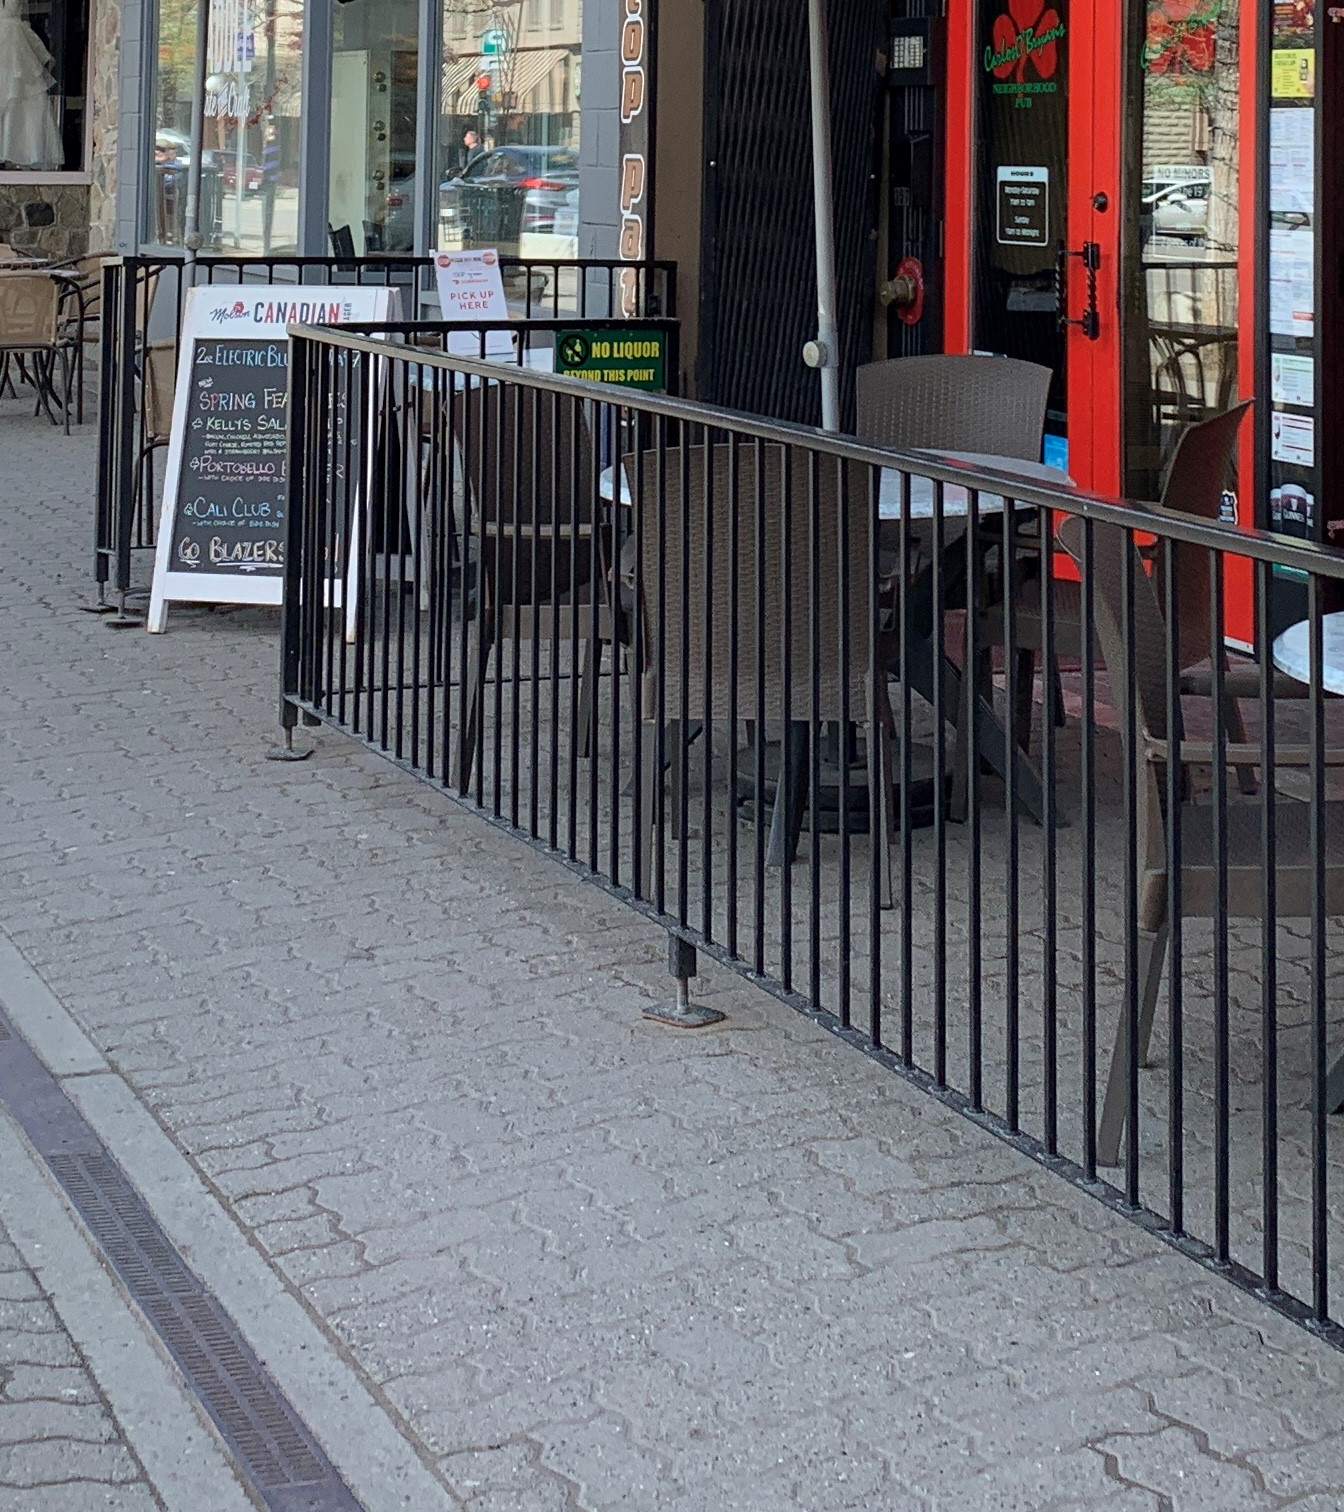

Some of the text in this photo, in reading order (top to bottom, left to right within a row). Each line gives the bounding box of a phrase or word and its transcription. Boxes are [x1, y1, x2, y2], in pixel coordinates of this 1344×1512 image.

[450, 290, 494, 300] PICK UP
[253, 301, 340, 324] CANADIAN
[459, 300, 489, 310] HERE
[215, 344, 265, 366] ELECTRIC
[591, 341, 660, 360] NO LIQUOR
[602, 369, 625, 382] THIS
[626, 369, 655, 382] POINT
[199, 392, 256, 410] SPRING
[200, 455, 275, 474] PORTOBELLO
[194, 496, 228, 518] CALI
[232, 497, 271, 518] CLUB
[178, 537, 201, 560] GO
